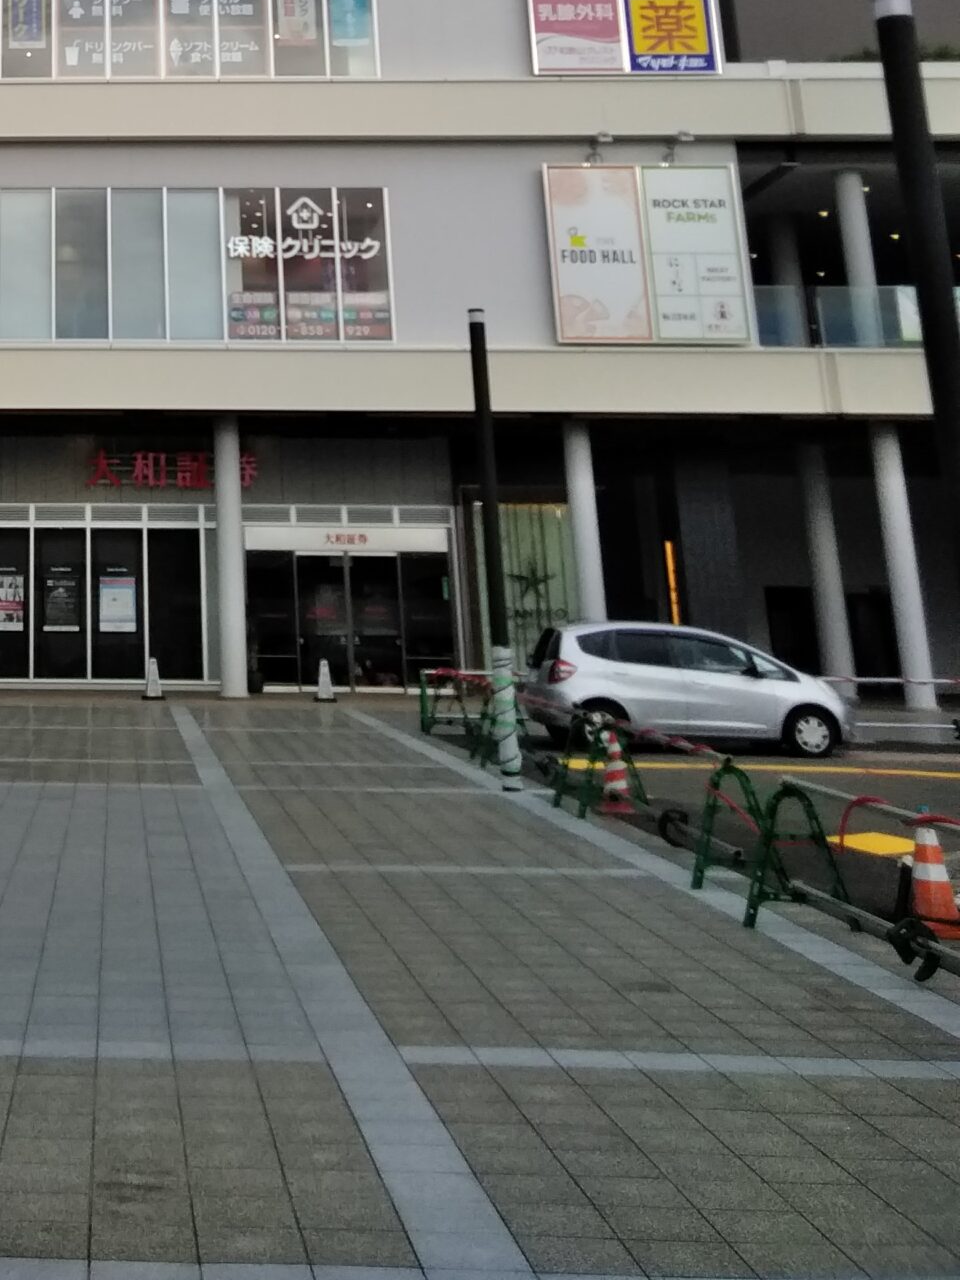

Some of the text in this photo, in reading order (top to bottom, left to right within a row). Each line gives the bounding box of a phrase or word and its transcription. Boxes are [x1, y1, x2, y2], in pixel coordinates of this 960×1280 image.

[639, 0, 699, 52] 薬
[652, 199, 726, 209] ROCK STAR
[228, 236, 381, 259] 保険クリニック
[561, 249, 637, 264] FOOD HALL
